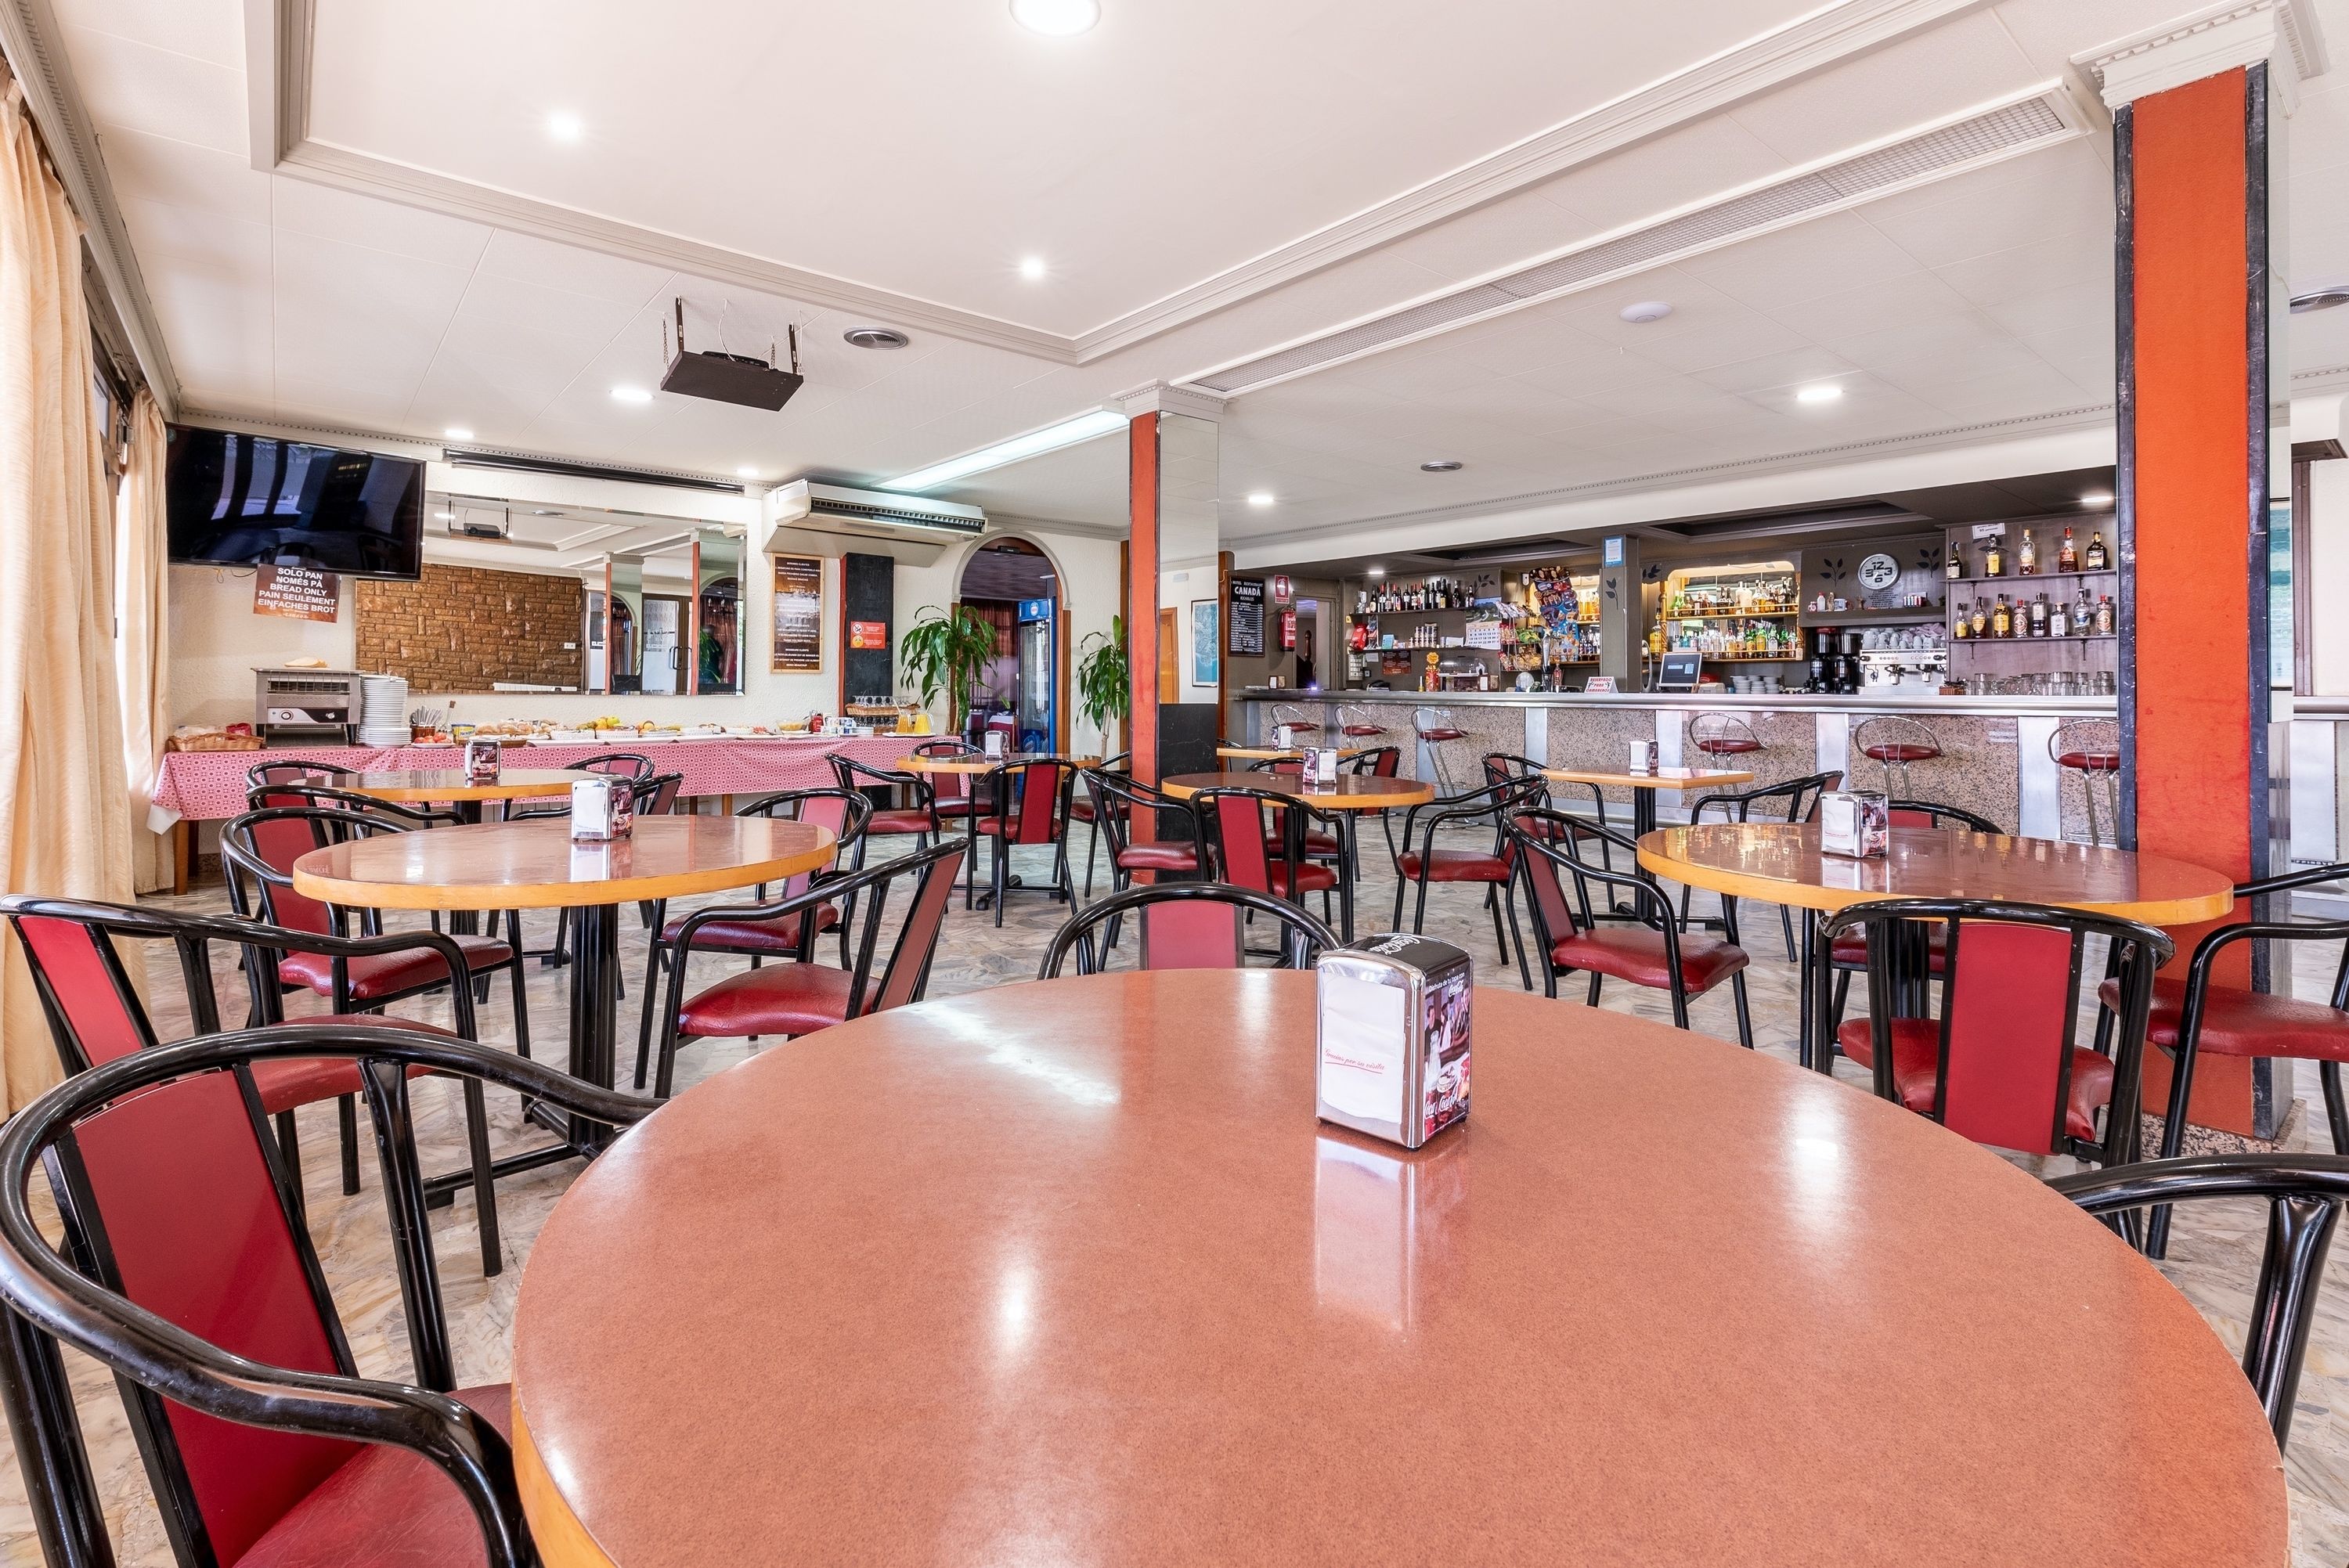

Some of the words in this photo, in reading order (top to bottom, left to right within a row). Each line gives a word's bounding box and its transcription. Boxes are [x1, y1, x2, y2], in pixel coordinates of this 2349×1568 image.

[1871, 561, 1885, 571] 12
[1884, 567, 1893, 576] 3
[277, 567, 304, 578] SOLO
[305, 571, 323, 580] PAN
[276, 575, 309, 586] NOMÉS
[310, 580, 323, 589] PÀ
[269, 583, 302, 593] BREAD
[303, 587, 327, 597] ONLY
[1234, 586, 1261, 597] CANADÁ
[258, 590, 280, 599] PAIN
[282, 593, 336, 606] SEULEMENT
[258, 598, 309, 611] EINFACHES
[311, 604, 335, 614] BROT
[1428, 982, 1443, 993] Disfruta
[1451, 975, 1460, 983] tapa
